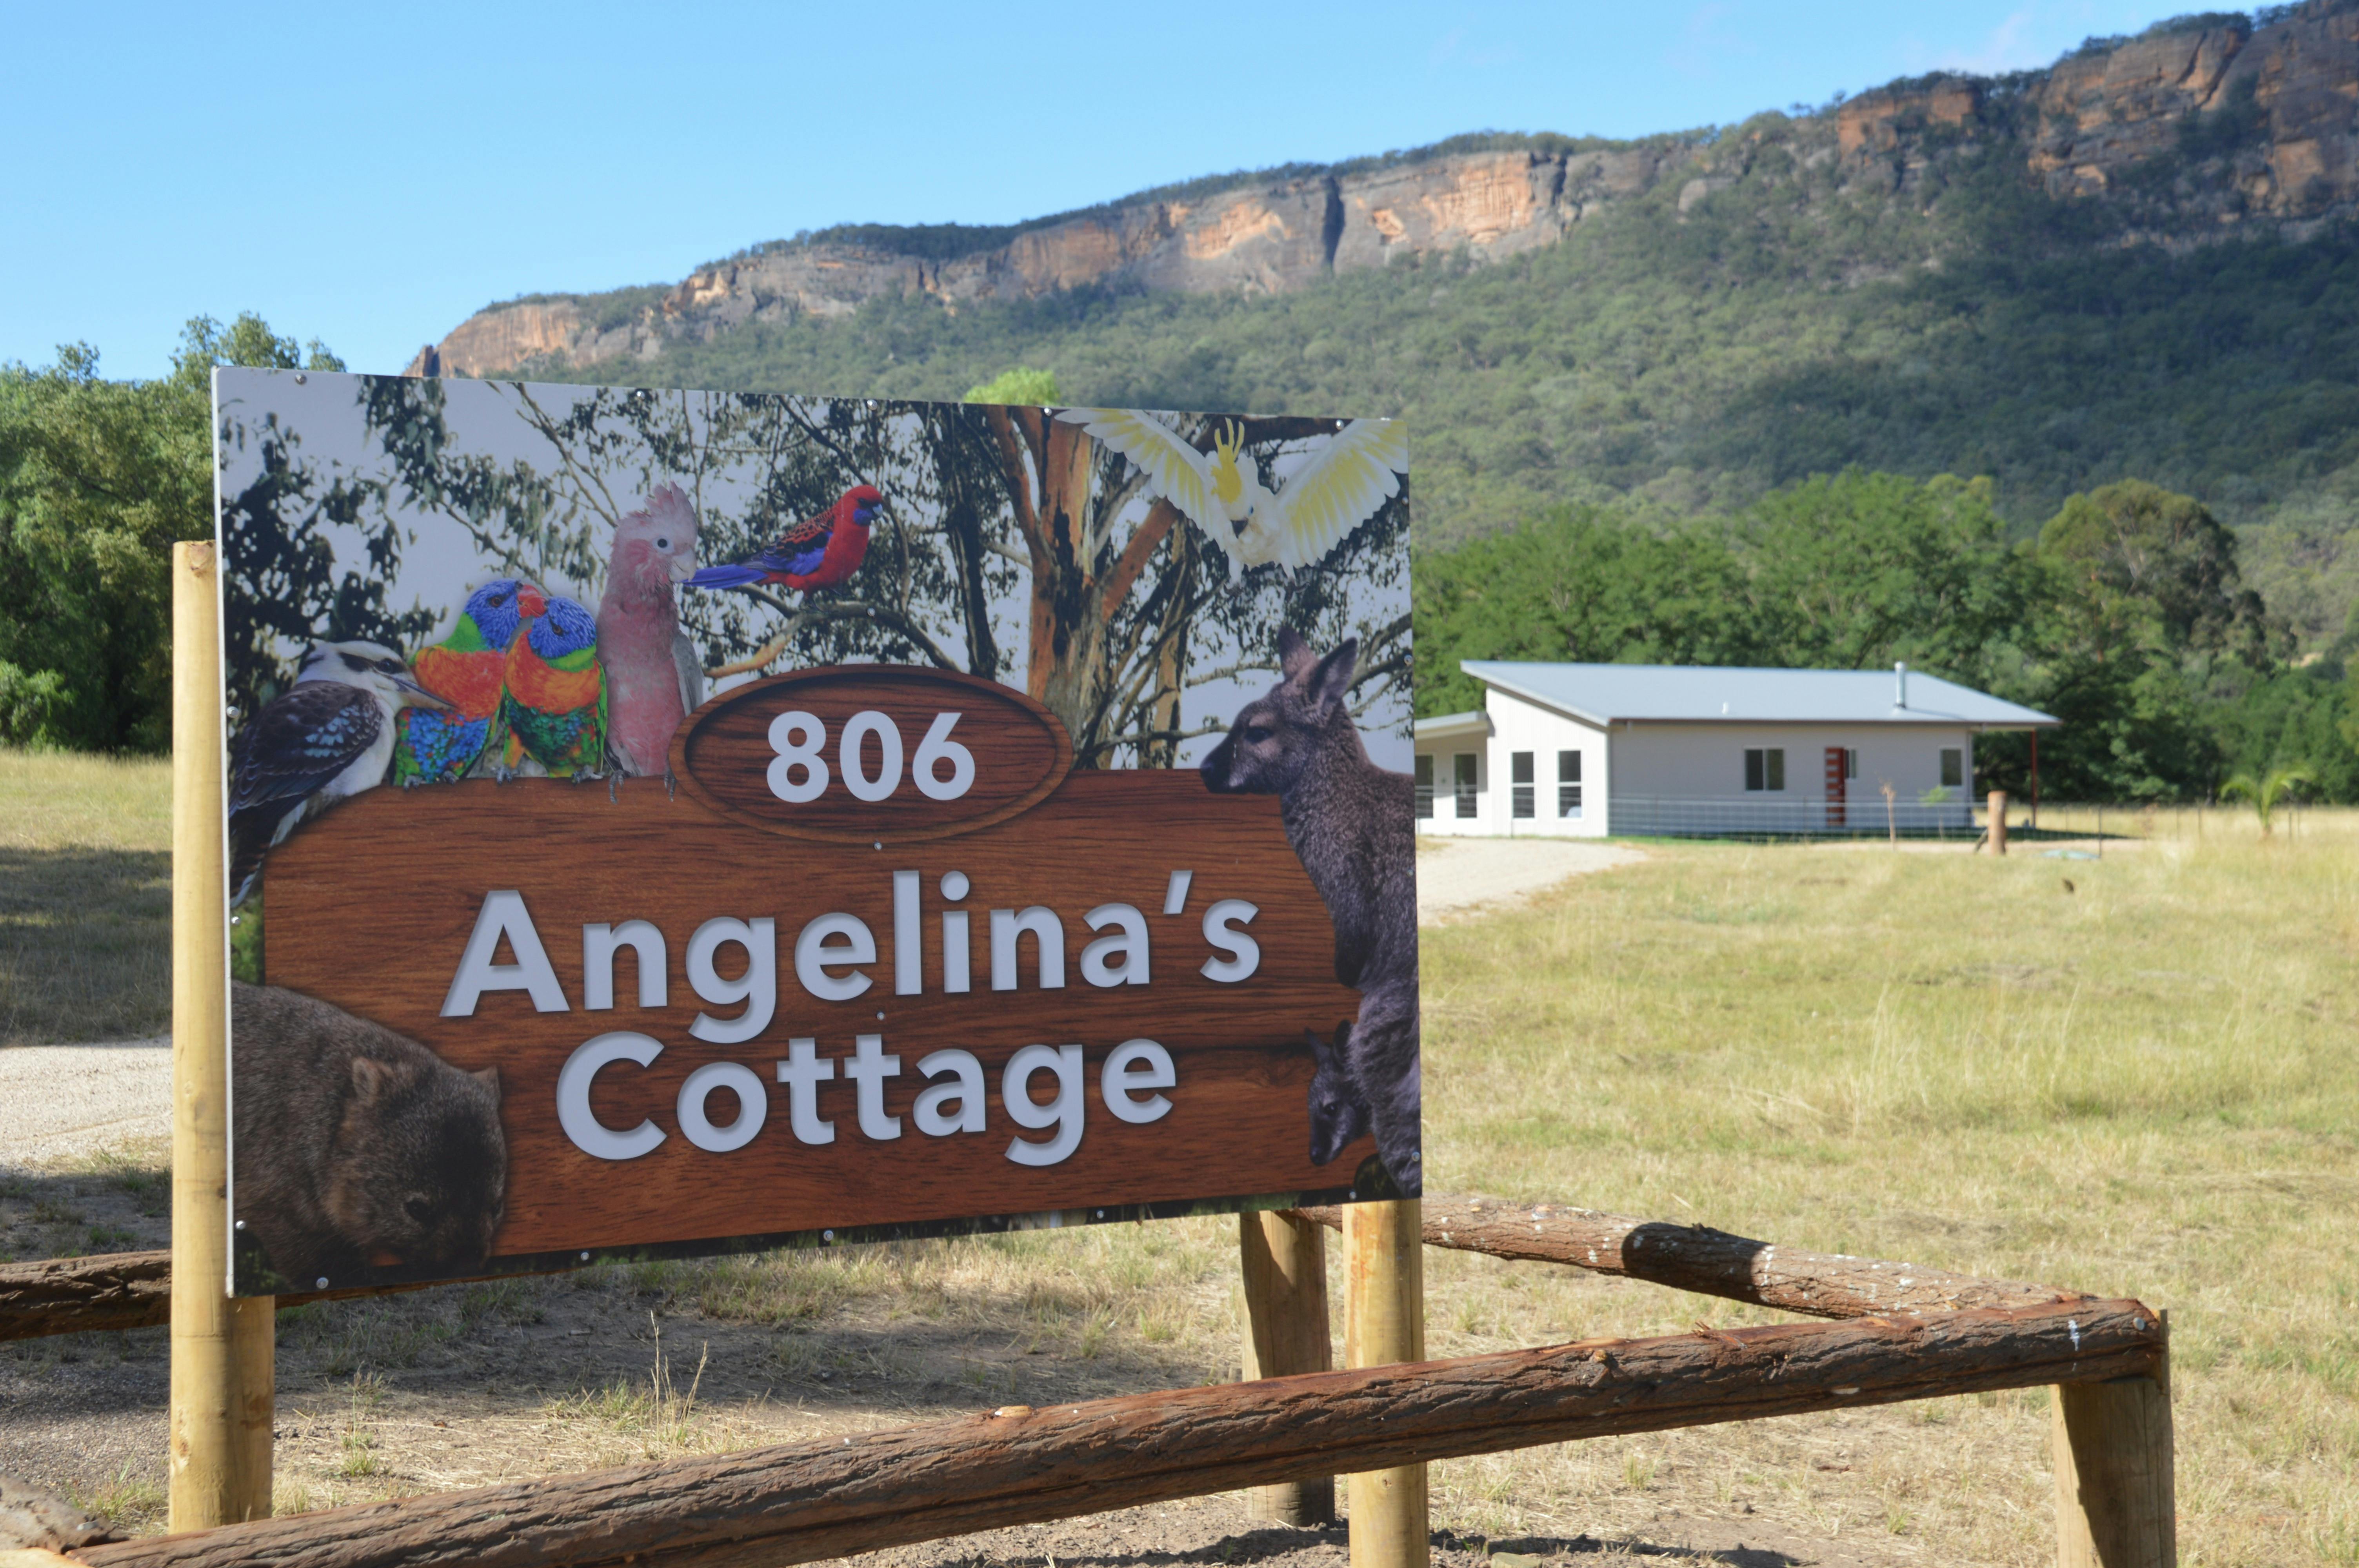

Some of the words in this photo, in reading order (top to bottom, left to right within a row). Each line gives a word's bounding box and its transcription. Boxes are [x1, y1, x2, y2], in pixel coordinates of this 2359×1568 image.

[765, 710, 976, 804] 806
[438, 869, 1261, 1044] Angelina's
[556, 1030, 1177, 1167] Cottage
